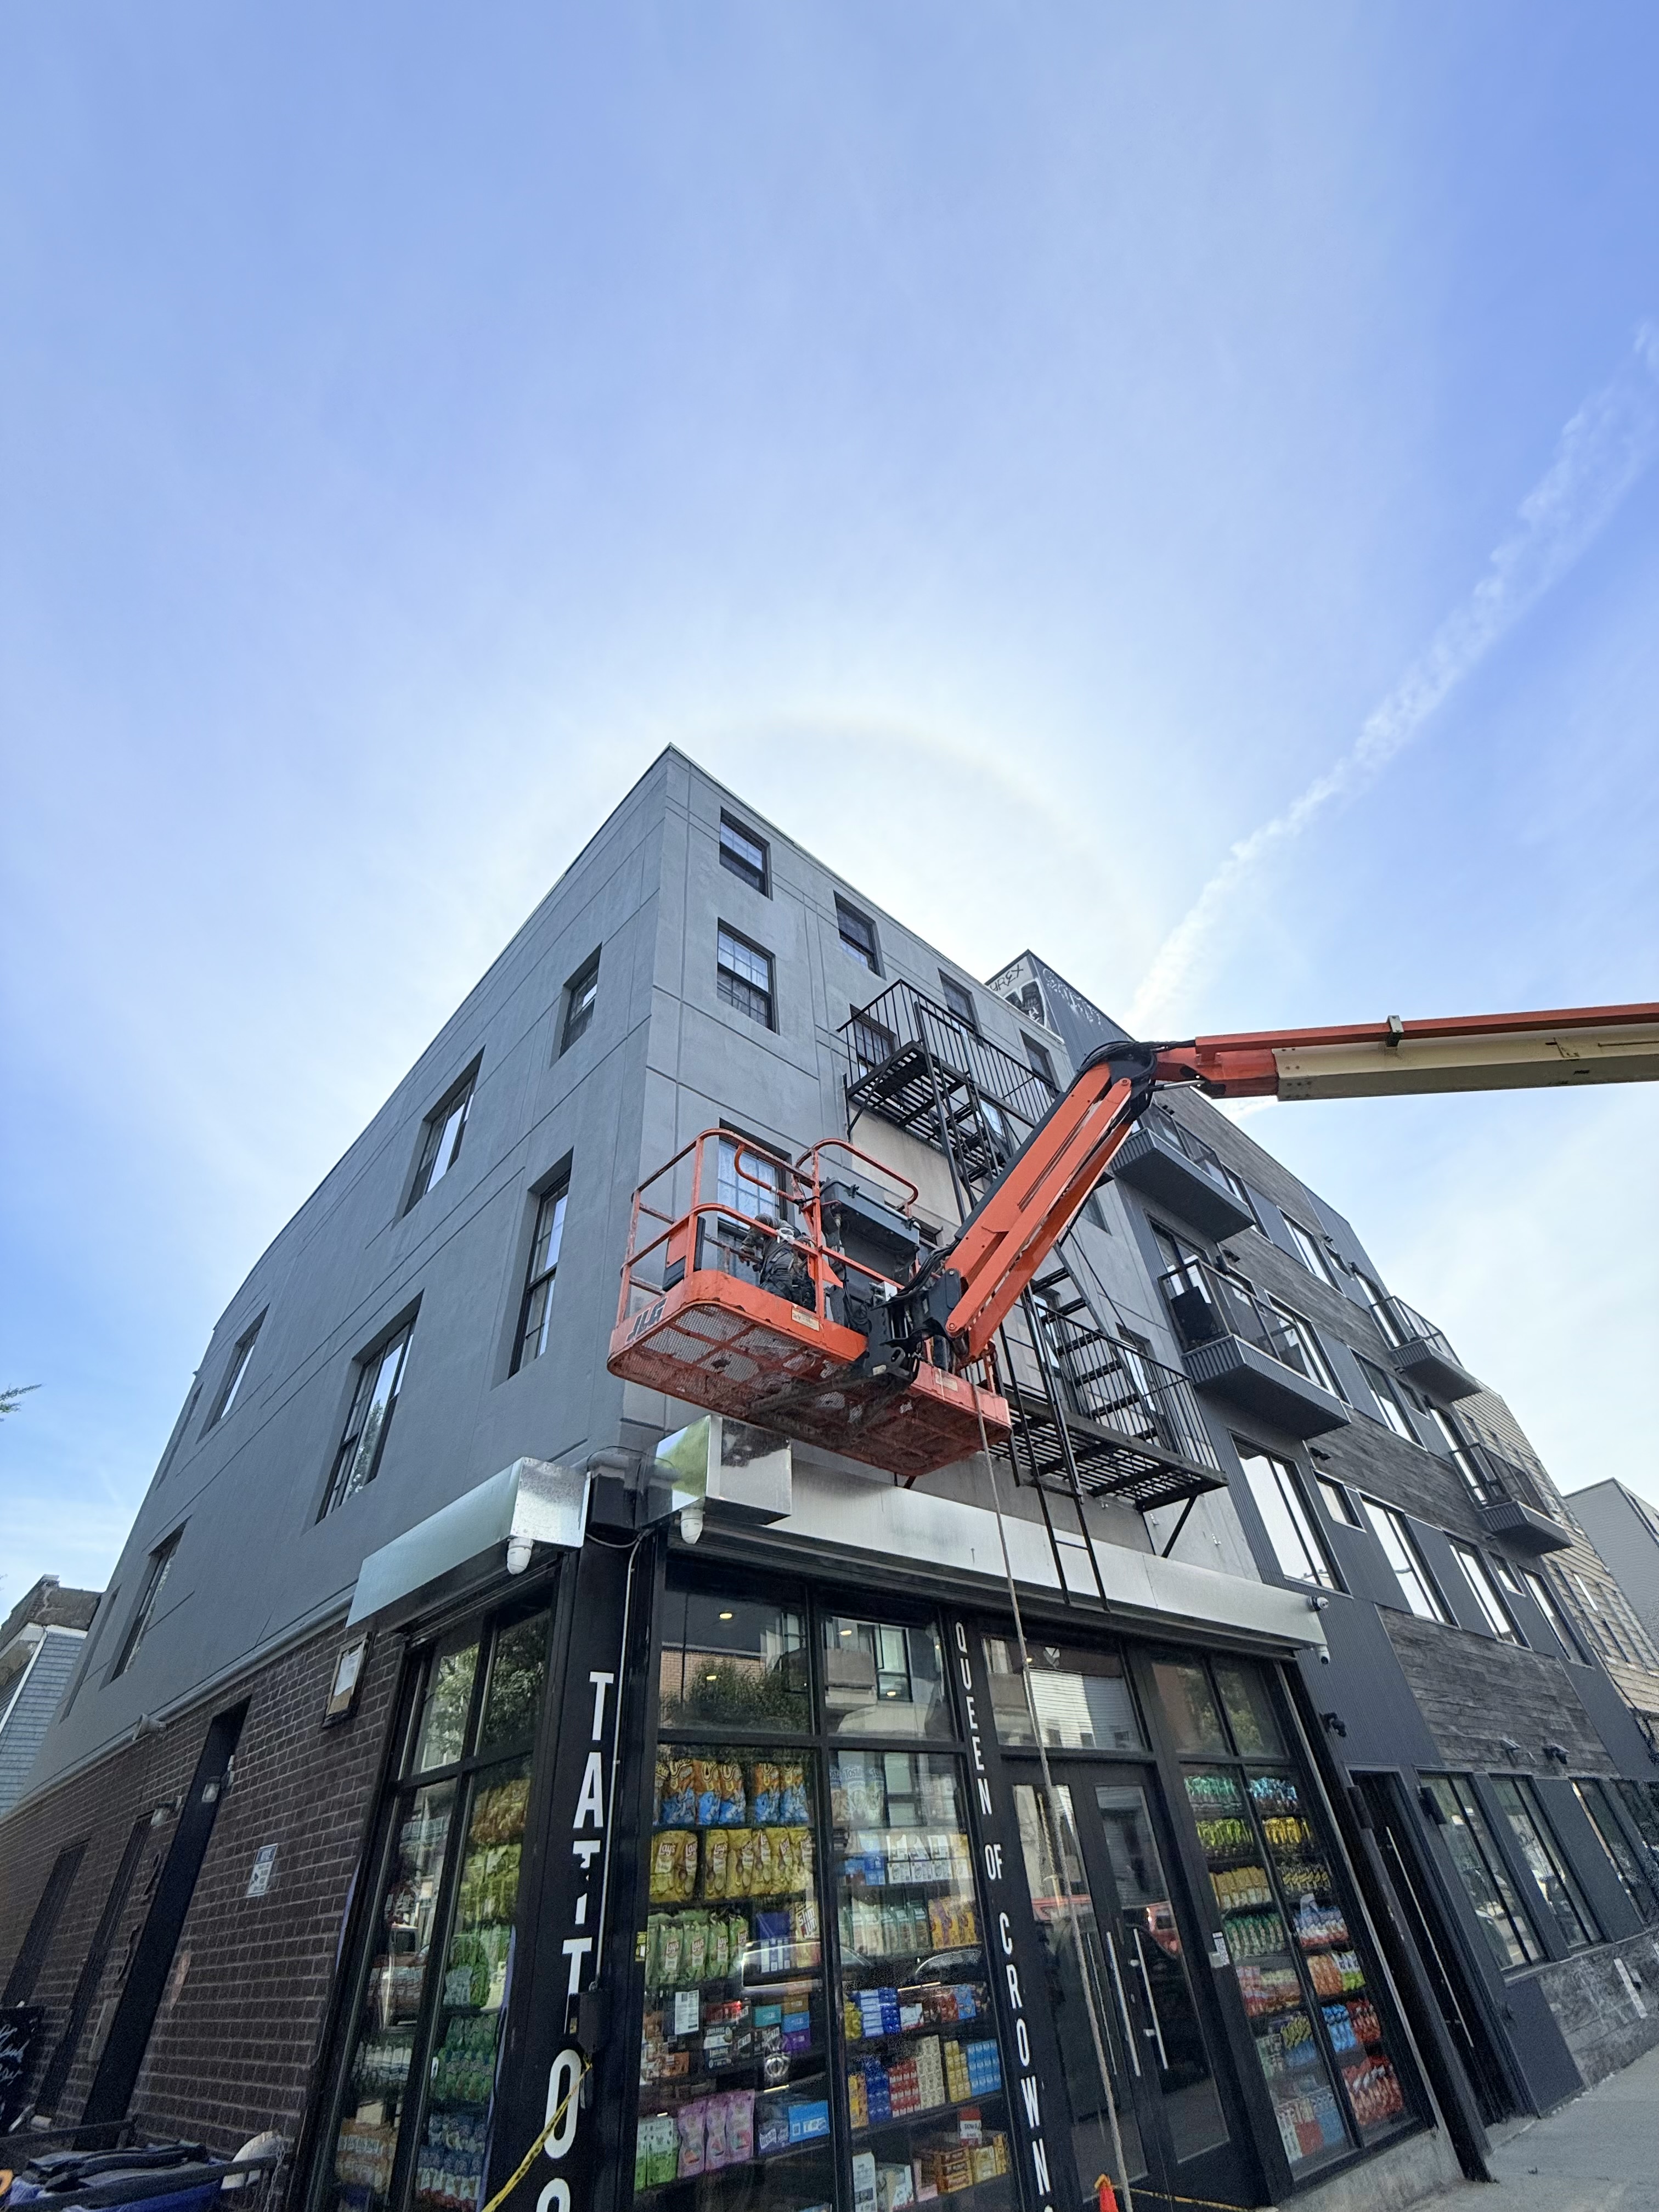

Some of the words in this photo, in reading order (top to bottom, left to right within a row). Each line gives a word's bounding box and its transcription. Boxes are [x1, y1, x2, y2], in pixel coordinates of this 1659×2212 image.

[625, 1296, 668, 1343] JLG
[955, 1622, 992, 1815] QUEEN
[985, 1843, 1002, 1881] OF
[999, 1912, 1053, 2212] CROWN
